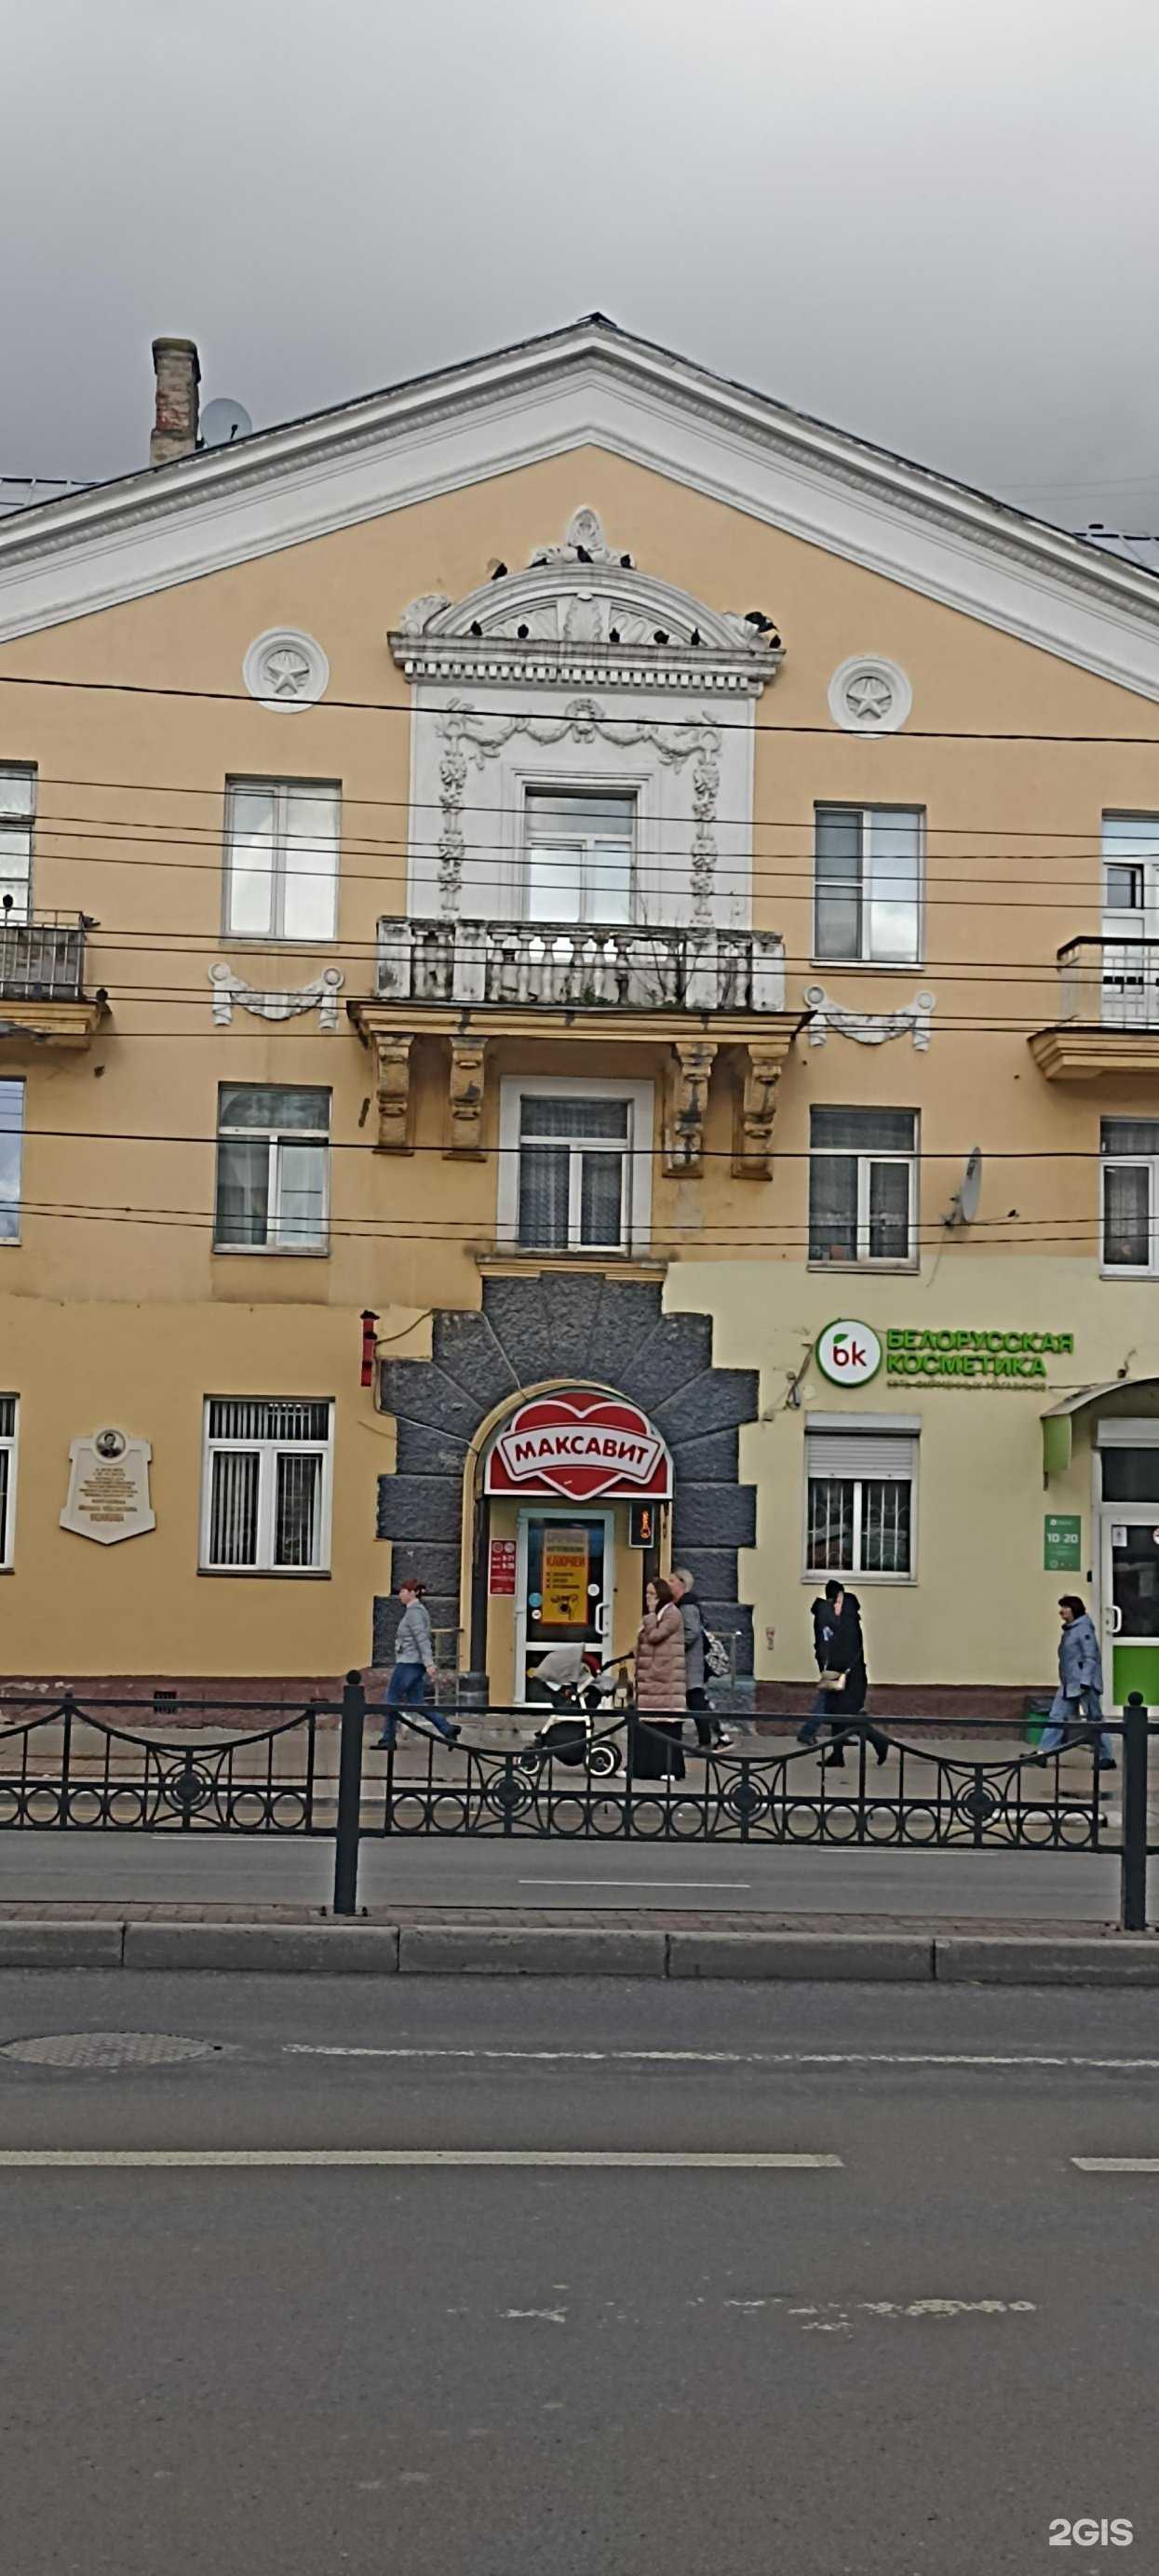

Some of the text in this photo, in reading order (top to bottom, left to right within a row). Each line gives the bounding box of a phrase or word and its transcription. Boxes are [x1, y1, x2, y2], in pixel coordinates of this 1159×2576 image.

[886, 1328, 1073, 1354] БЕЛОРУССКАЯ
[886, 1353, 1046, 1377] КОСМЕТИКА
[514, 1436, 649, 1464] МАКСАВИТ
